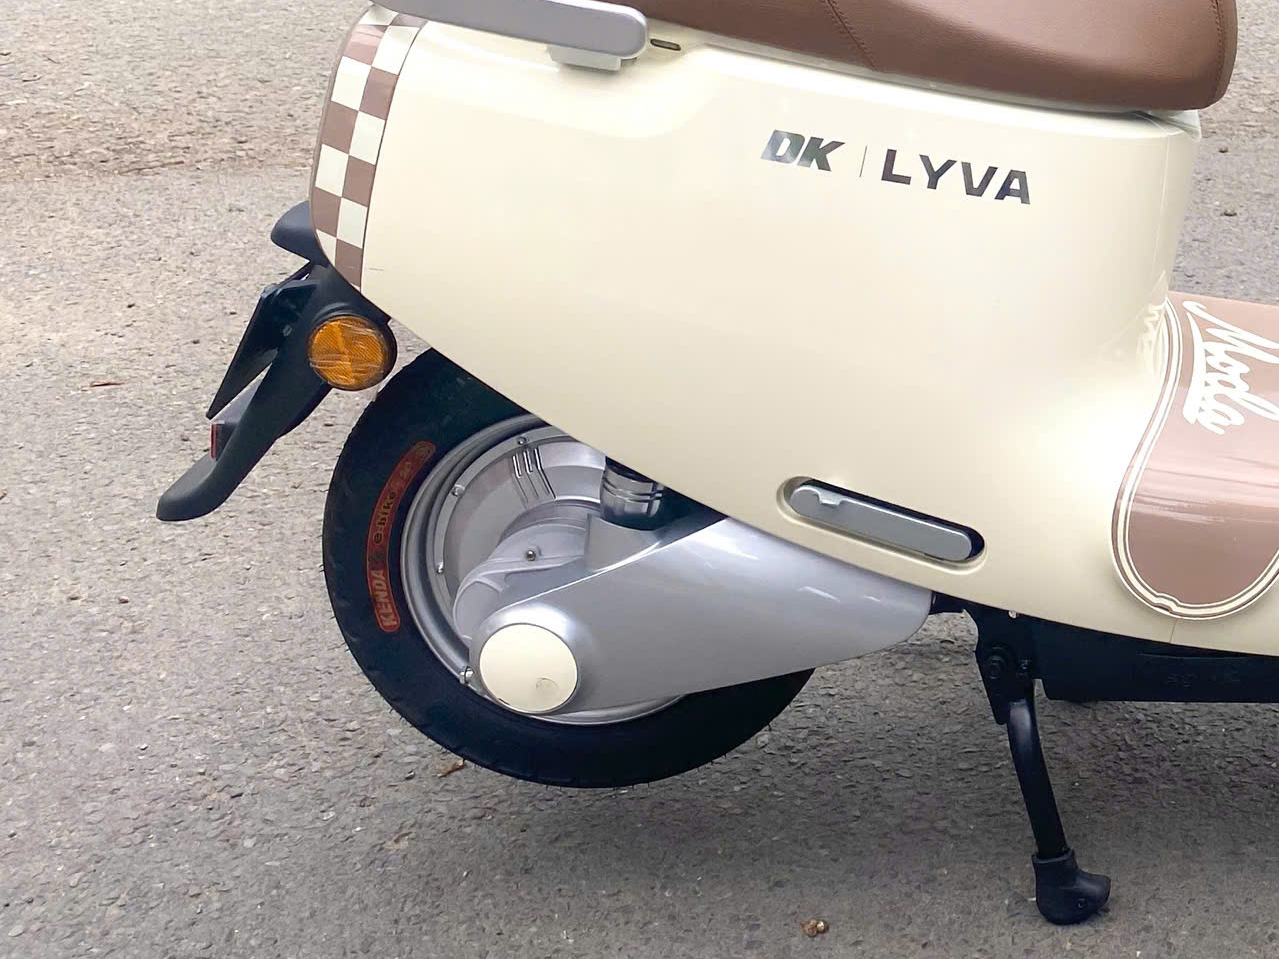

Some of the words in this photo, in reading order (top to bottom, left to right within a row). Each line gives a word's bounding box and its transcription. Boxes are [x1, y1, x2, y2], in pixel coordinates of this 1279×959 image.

[760, 129, 846, 172] DK
[881, 148, 1031, 205] LYVA
[370, 569, 398, 626] KENDA
